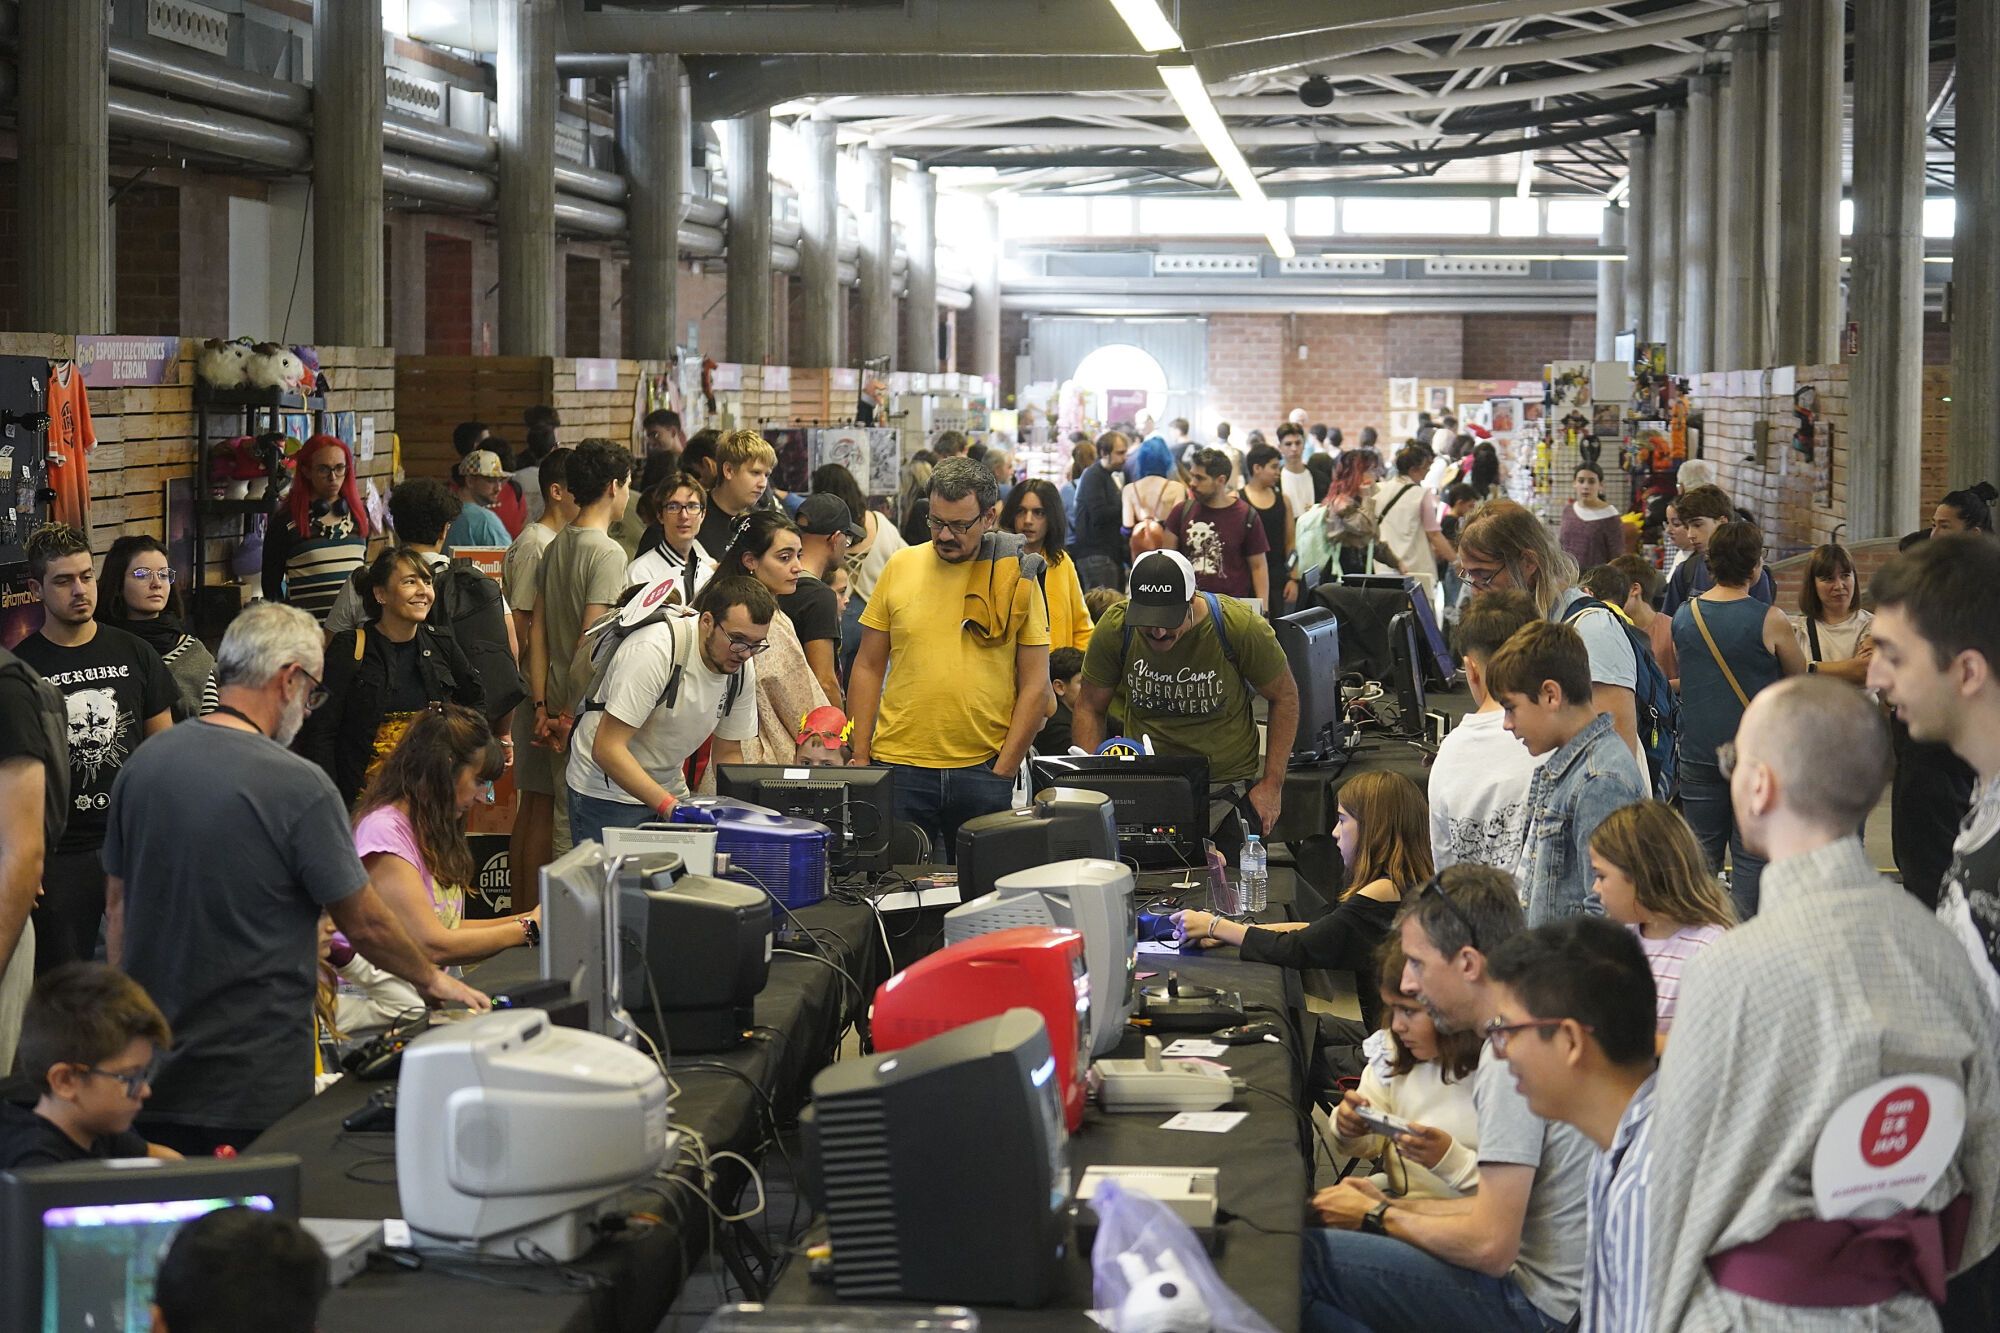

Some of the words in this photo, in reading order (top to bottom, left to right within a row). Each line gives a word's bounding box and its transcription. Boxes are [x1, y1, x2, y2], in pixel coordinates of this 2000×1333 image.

[96, 342, 122, 360] ESPORTS
[112, 361, 121, 379] DE
[121, 361, 147, 378] GIRONA
[1133, 659, 1174, 683] Vinson
[1176, 667, 1217, 684] Camp
[1127, 673, 1223, 699] GEOGRAPHIC
